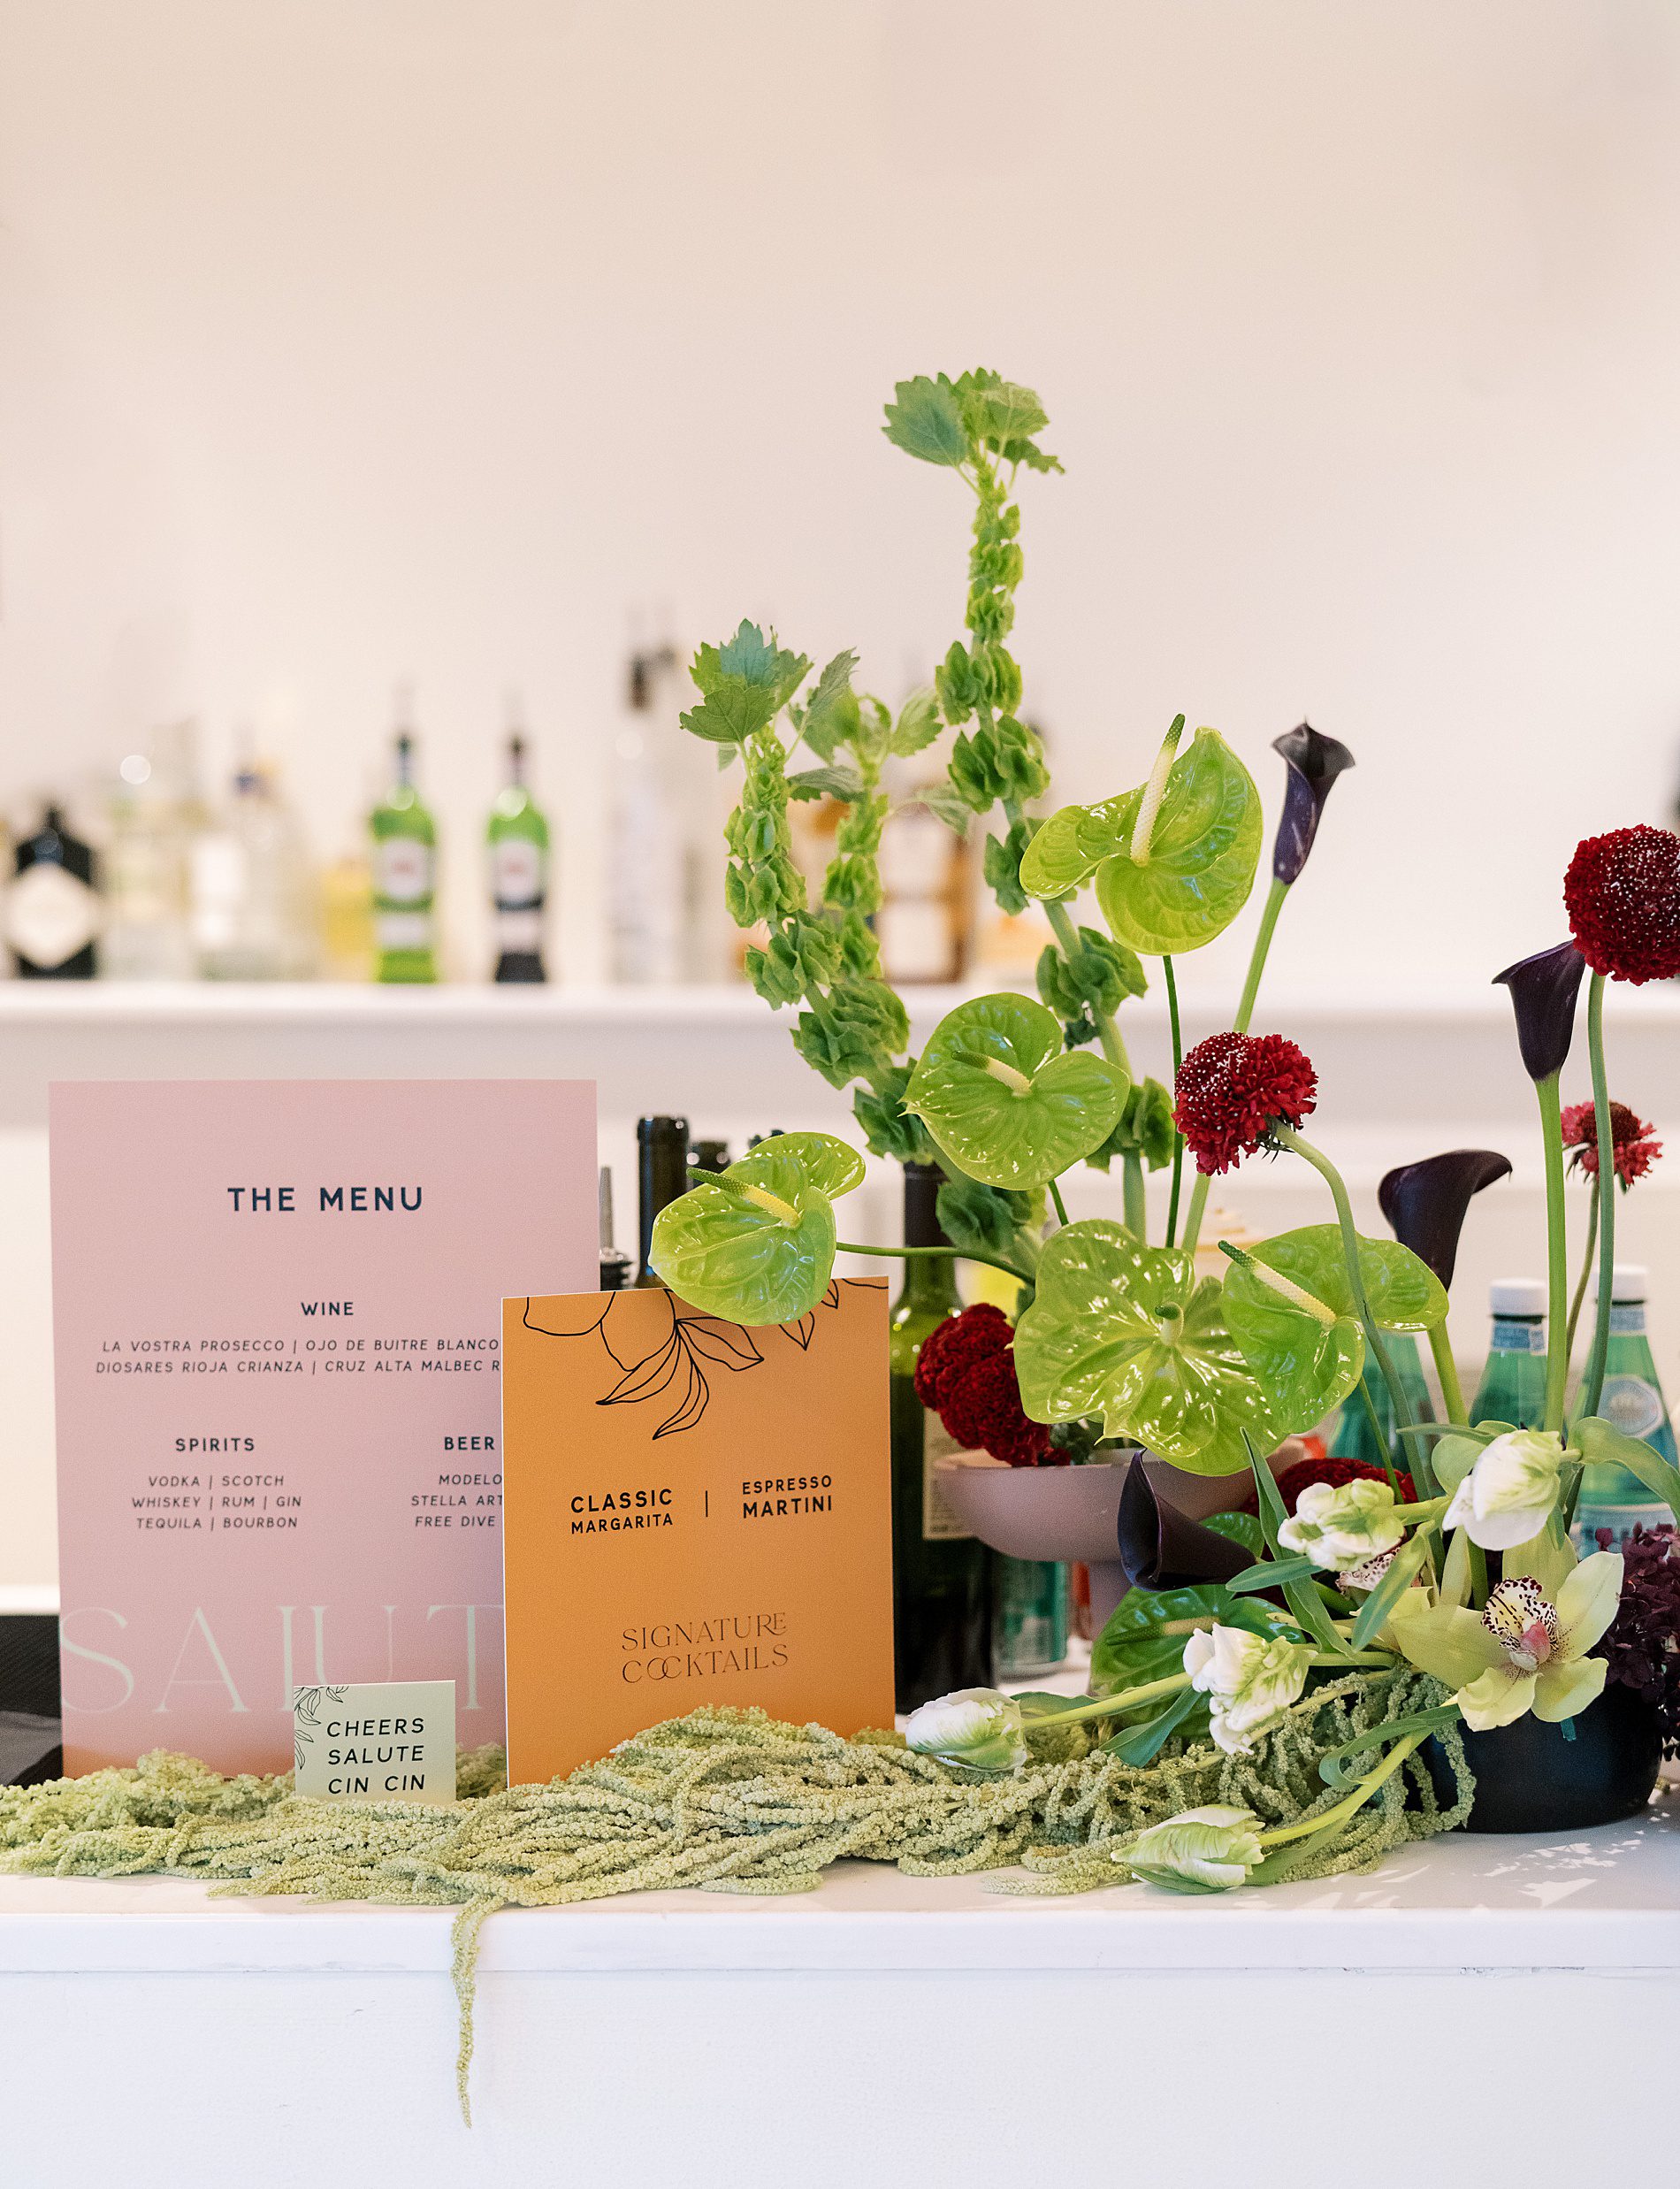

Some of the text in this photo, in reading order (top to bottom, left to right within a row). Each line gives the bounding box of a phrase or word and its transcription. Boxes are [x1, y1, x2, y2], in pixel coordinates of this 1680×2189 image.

[227, 1186, 423, 1213] THE MENU
[301, 1301, 355, 1317] WINE
[103, 1341, 121, 1352] LA
[130, 1341, 192, 1352] VOSTRA
[200, 1340, 285, 1352] PROSECCO
[305, 1339, 338, 1351] OJO
[346, 1339, 365, 1351] DE
[373, 1338, 429, 1351] BUITRE
[436, 1338, 500, 1351] BLANCO
[95, 1362, 173, 1374] DIOSARES
[181, 1361, 228, 1374] RIOJA
[236, 1361, 303, 1373] CRIANZA
[325, 1360, 366, 1373] CRUZ
[374, 1360, 413, 1373] ALTA
[420, 1359, 484, 1372] MALBEC
[174, 1437, 256, 1453] SPIRITS
[443, 1435, 496, 1451] BEER
[148, 1475, 200, 1488] VODKA
[221, 1475, 285, 1488] SCOTCH
[438, 1473, 502, 1486] MODELO
[742, 1475, 832, 1495] ESPRESSO
[131, 1496, 201, 1509] WHISKEY
[221, 1496, 256, 1508] RUM
[275, 1496, 302, 1508] GIN
[411, 1495, 468, 1507] STELLA
[570, 1489, 673, 1513] CLASSIC
[742, 1495, 832, 1519] MARTINI
[136, 1517, 202, 1530] TEQUILA
[223, 1516, 298, 1529] BOURBON
[415, 1515, 496, 1527] FREE DIVE
[570, 1513, 673, 1535] MARGARITA
[622, 1612, 787, 1651] SIGNATURE
[622, 1644, 789, 1684] COCKTAILS
[326, 1718, 424, 1738] CHEERS
[327, 1745, 424, 1766] SALUTE
[327, 1773, 425, 1795] CIN CIN
